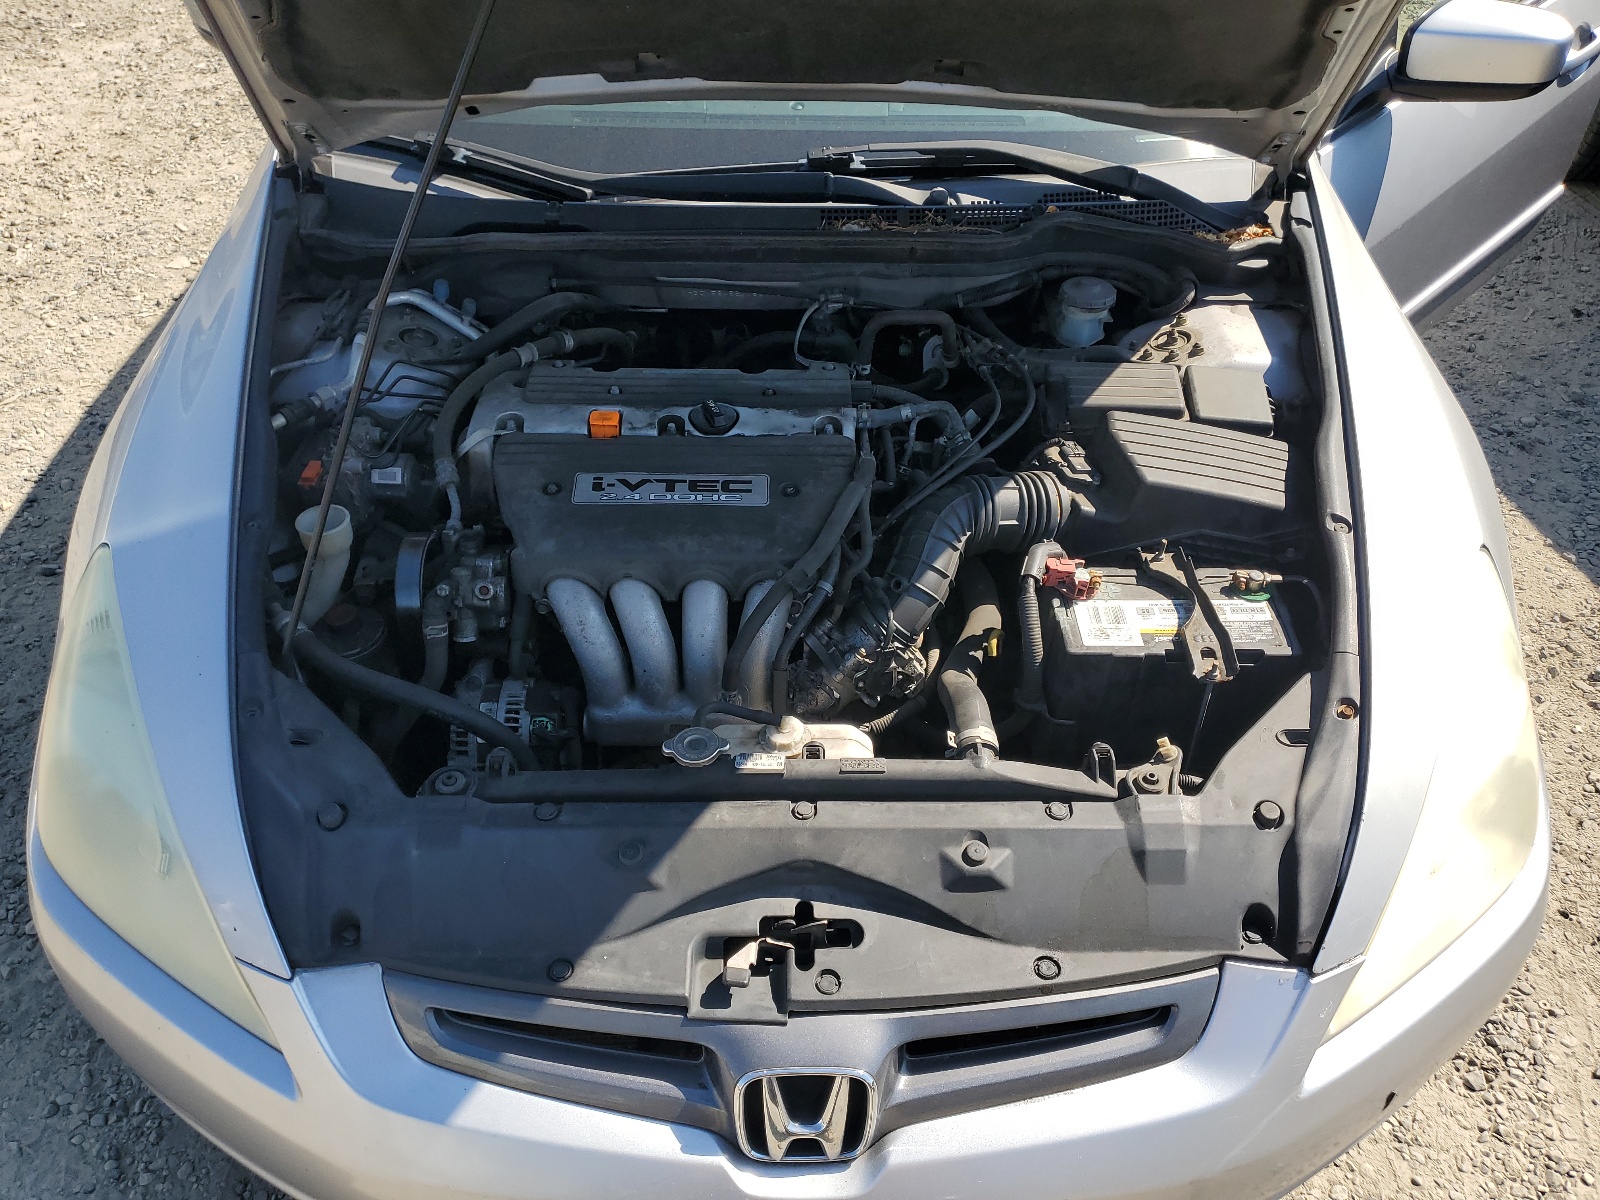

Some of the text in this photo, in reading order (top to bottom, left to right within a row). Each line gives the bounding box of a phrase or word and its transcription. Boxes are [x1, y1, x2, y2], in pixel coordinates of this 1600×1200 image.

[592, 476, 753, 493] i-VTEC
[600, 493, 743, 502] 2.4 DOHC
